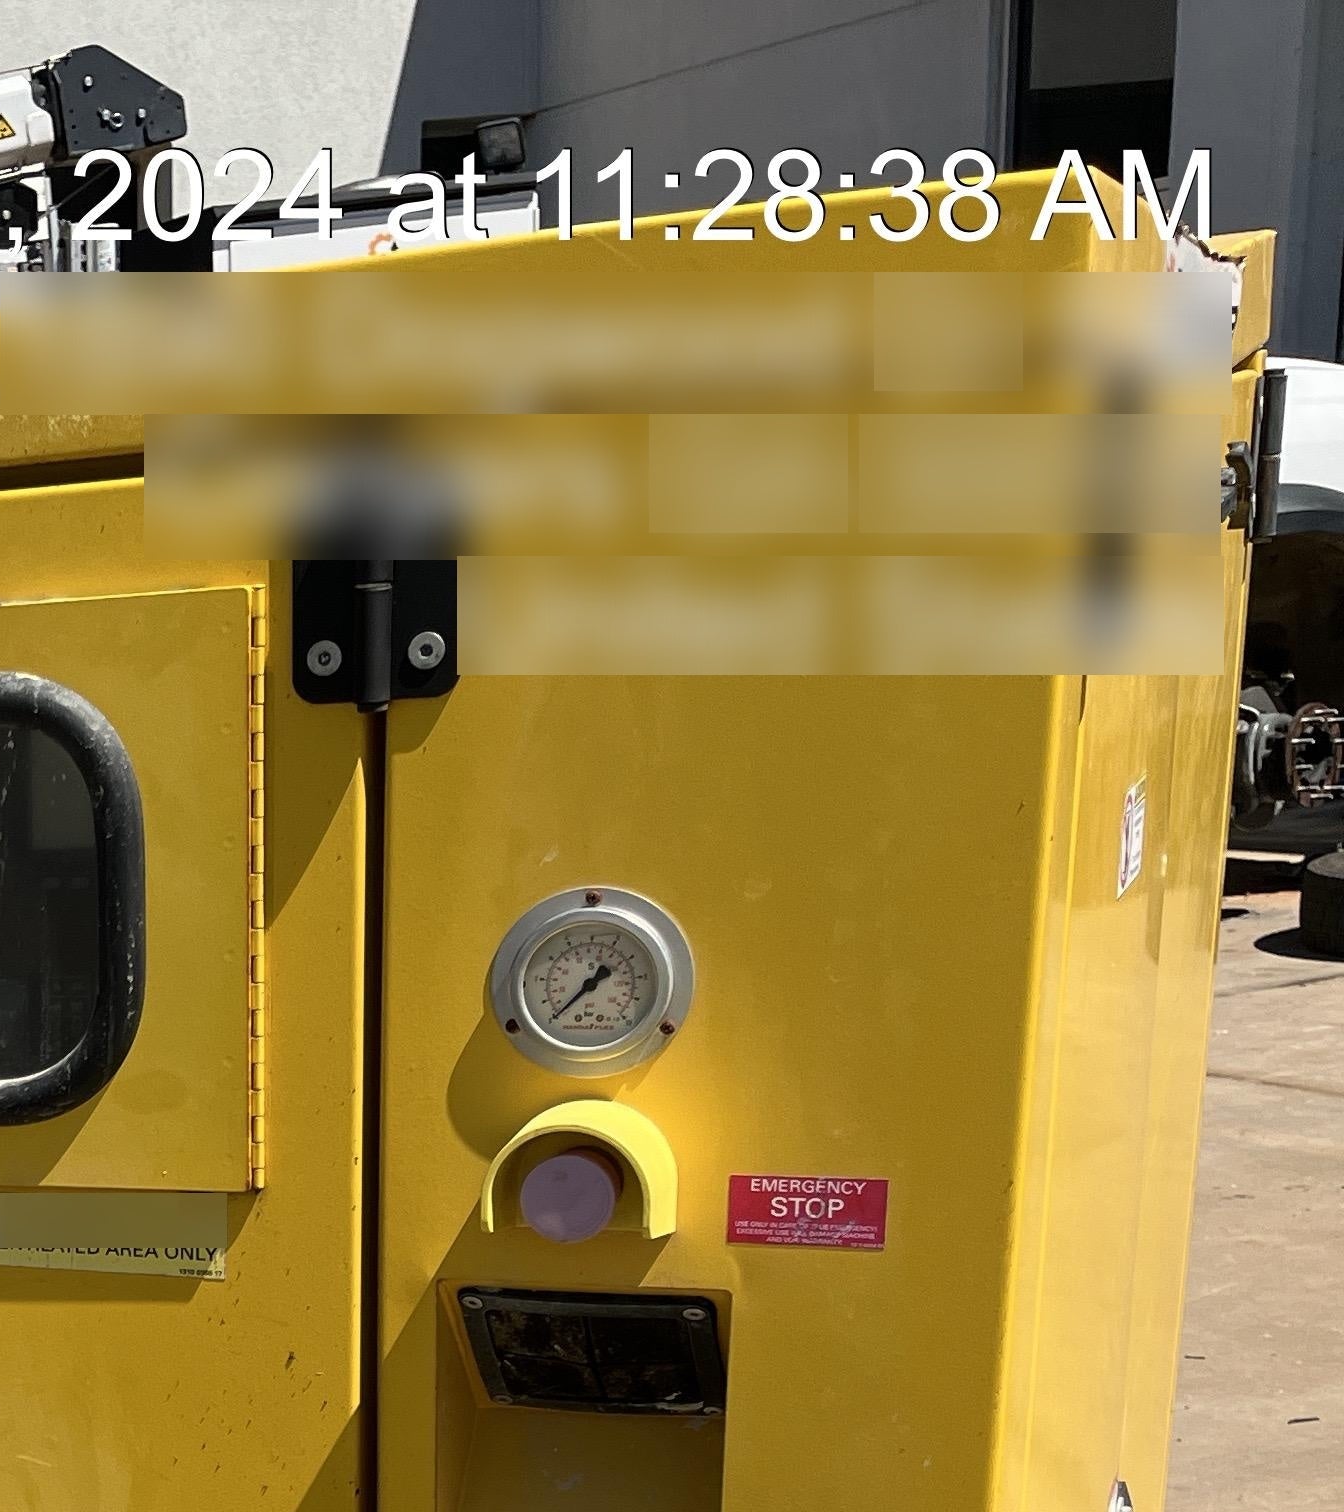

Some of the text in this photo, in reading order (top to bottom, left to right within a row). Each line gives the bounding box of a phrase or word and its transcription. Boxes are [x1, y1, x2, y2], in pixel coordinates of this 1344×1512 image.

[750, 1178, 867, 1195] EMERGENCY
[770, 1196, 845, 1219] STOP
[164, 1247, 219, 1262] ONLY
